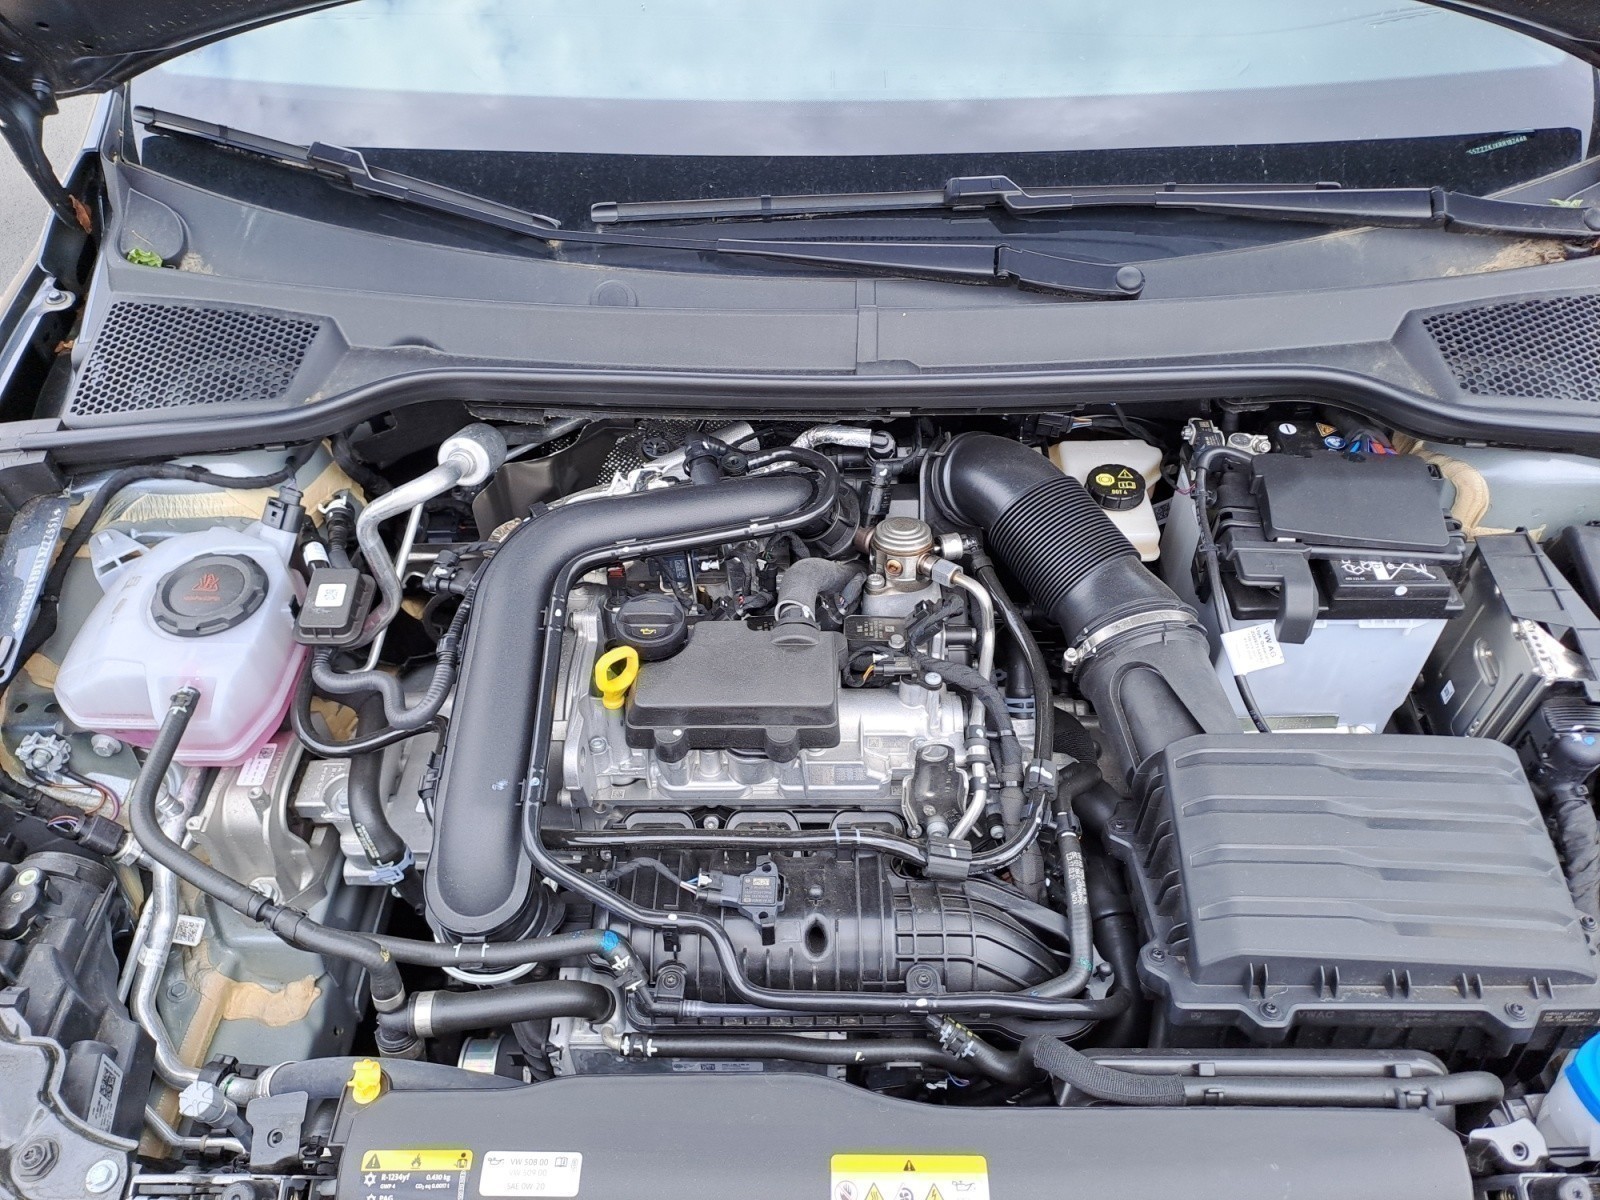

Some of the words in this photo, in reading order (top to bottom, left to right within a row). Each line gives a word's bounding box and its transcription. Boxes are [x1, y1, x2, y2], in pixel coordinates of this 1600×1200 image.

[1263, 629, 1272, 643] VW
[1268, 645, 1277, 658] AG
[510, 1158, 522, 1166] VW
[524, 1158, 537, 1166] 508
[539, 1158, 549, 1166] 00
[509, 1169, 521, 1177] VW
[523, 1169, 537, 1177] 509
[537, 1169, 547, 1177] 00
[381, 1173, 411, 1183] R-1234yf
[443, 1174, 451, 1182] kg
[507, 1182, 519, 1190] SAE
